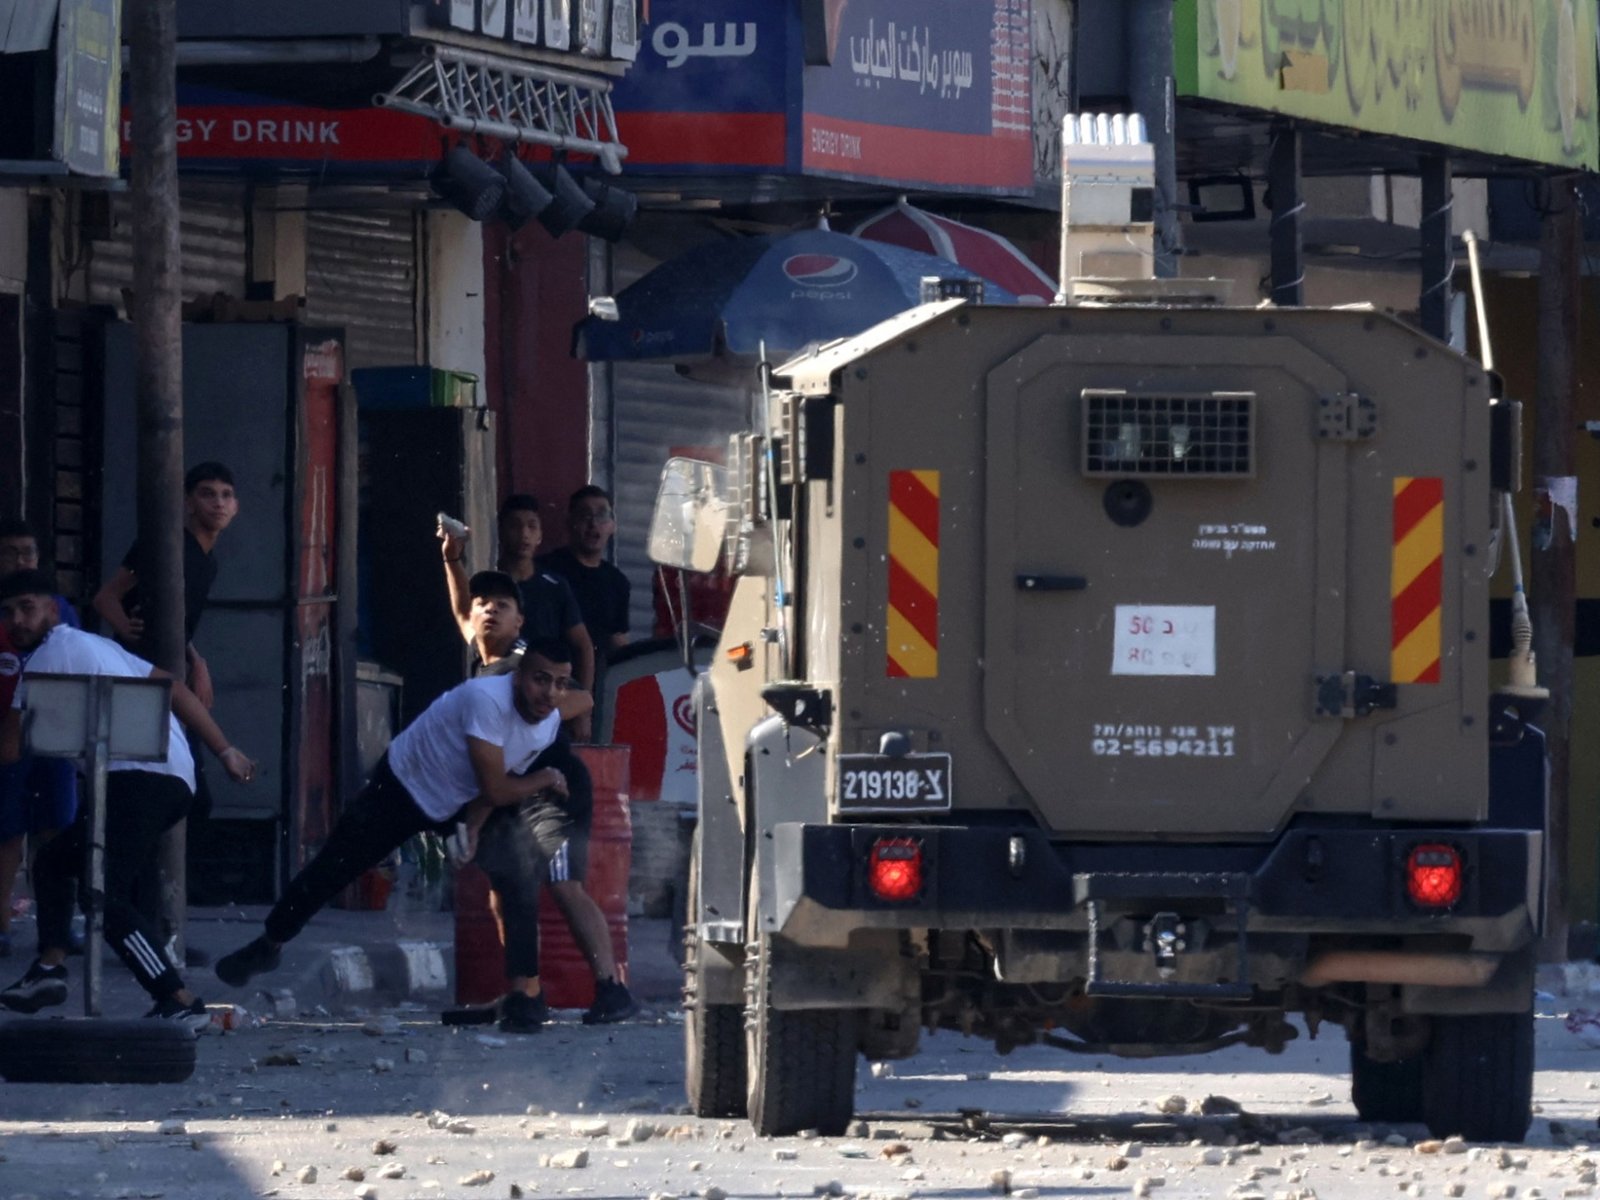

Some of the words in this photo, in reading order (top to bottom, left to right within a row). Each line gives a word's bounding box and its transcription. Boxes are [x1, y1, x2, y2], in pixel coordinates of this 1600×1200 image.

[849, 17, 896, 90] الحبايب
[897, 24, 939, 96] ماركت
[941, 49, 973, 100] سوبر
[232, 119, 340, 144] DRINK
[811, 127, 840, 156] ENERGY
[840, 132, 862, 160] DRINK
[791, 290, 851, 301] pepsi
[1092, 737, 1236, 757] 02-5694211
